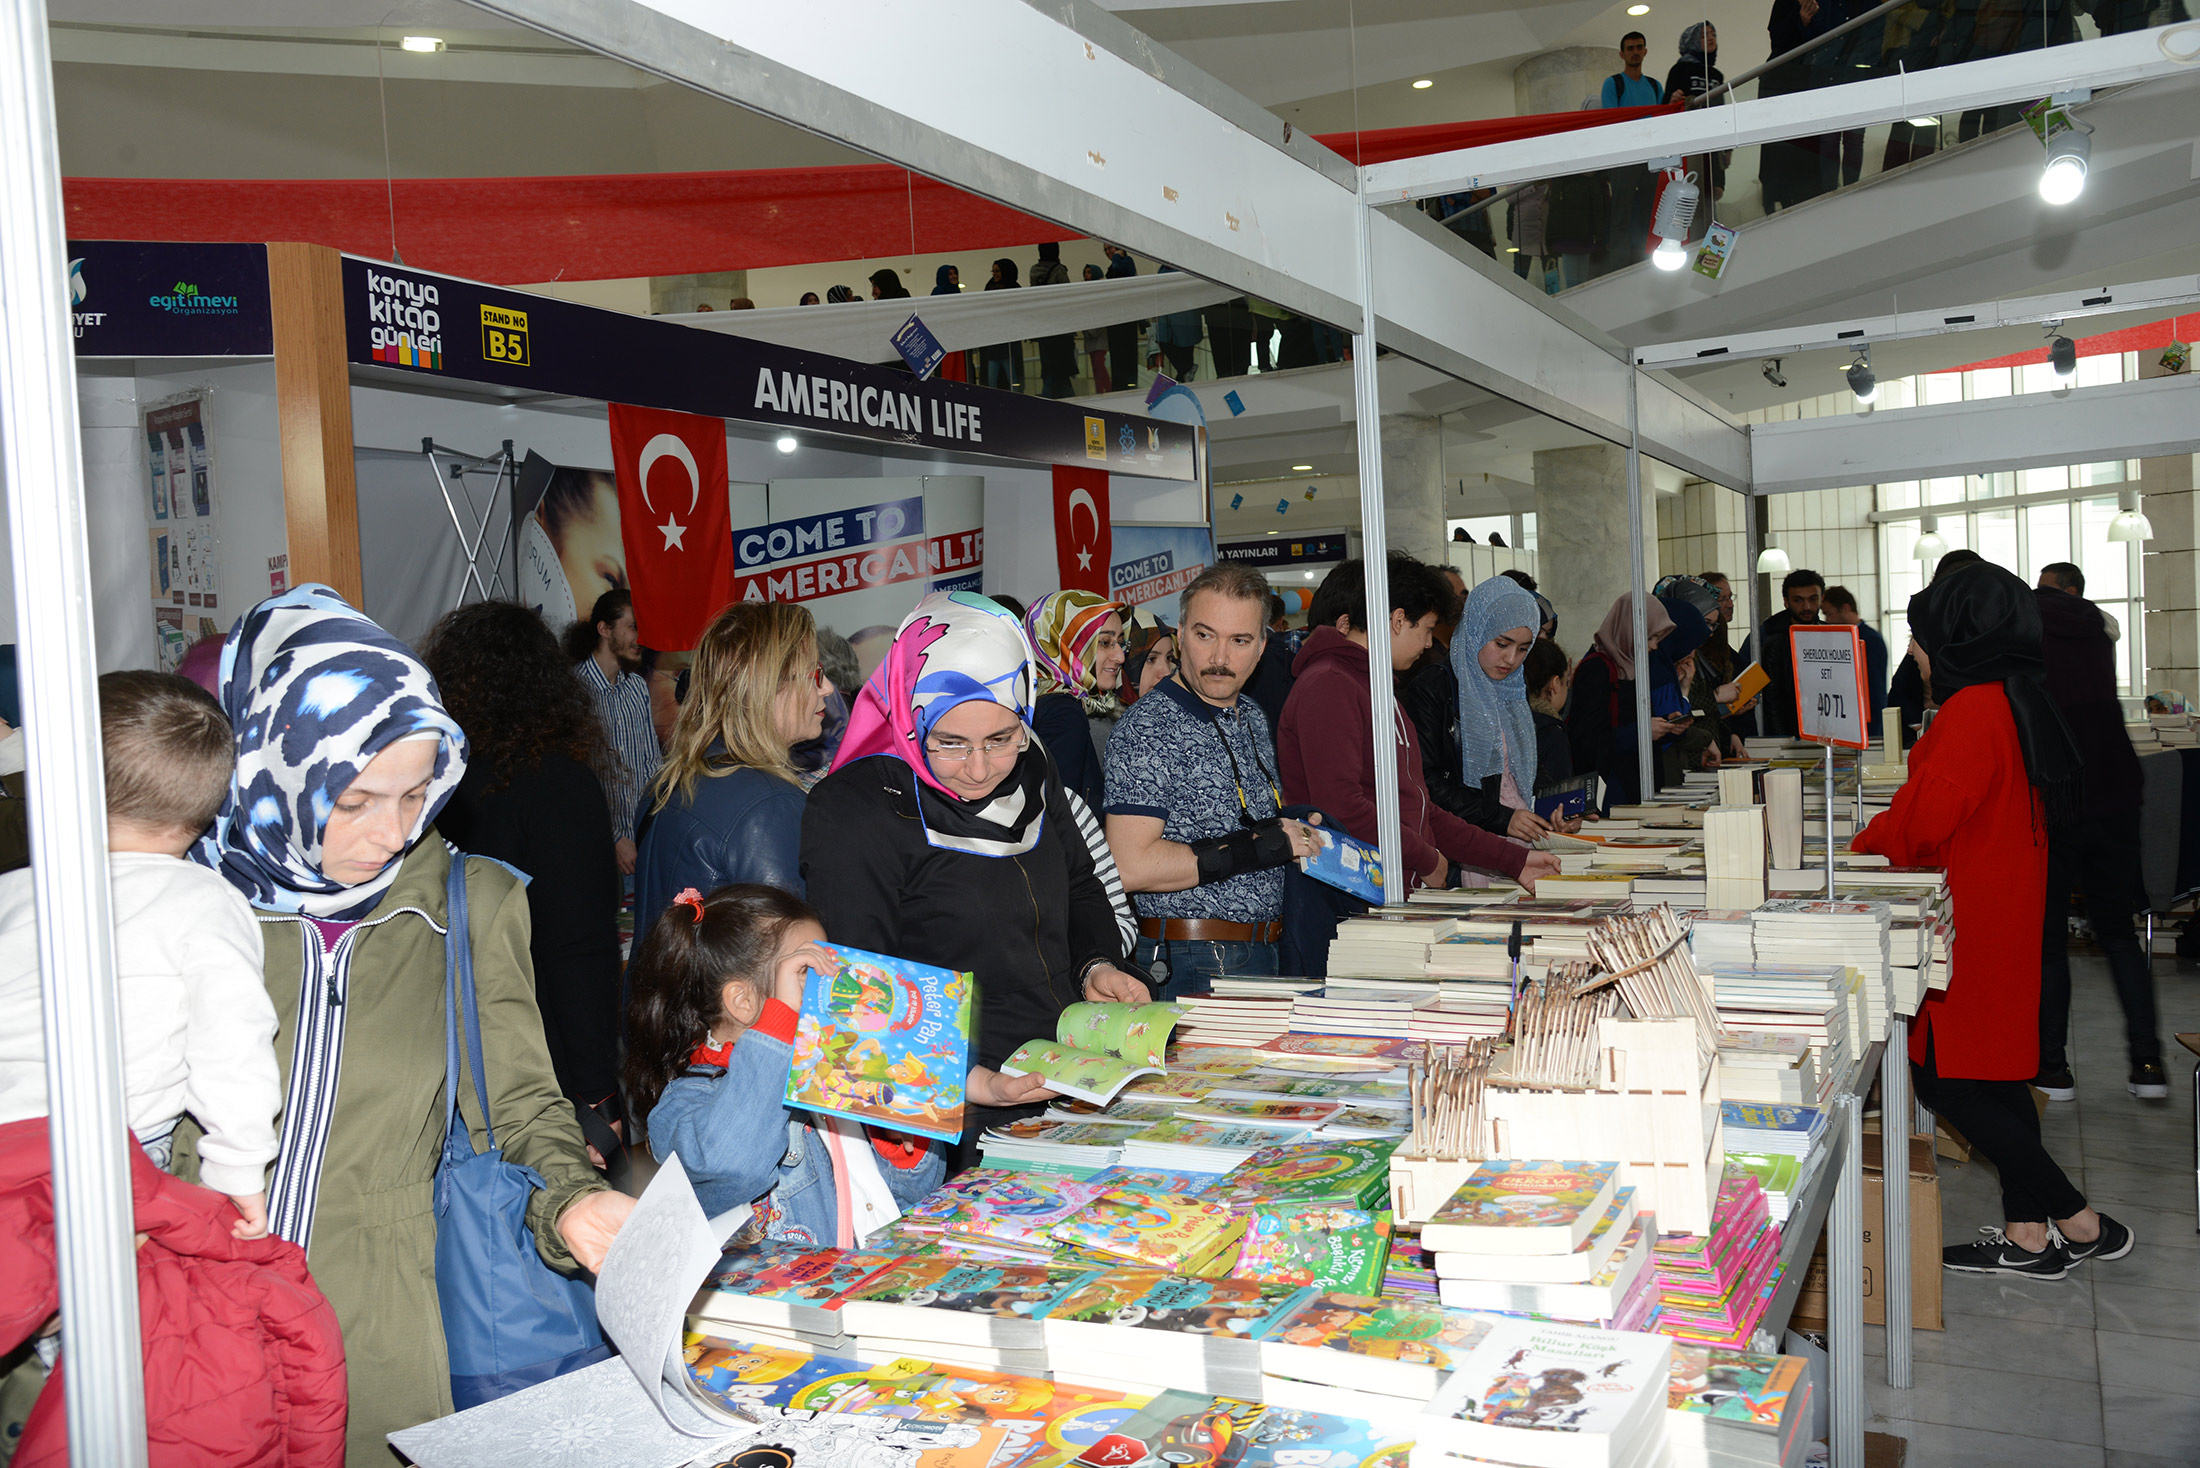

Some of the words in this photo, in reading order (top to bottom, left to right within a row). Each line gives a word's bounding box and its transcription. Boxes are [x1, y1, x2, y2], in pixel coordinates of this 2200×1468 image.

[367, 269, 439, 307] konya
[173, 307, 238, 316] Organizasyon
[369, 293, 440, 335] kitap
[483, 310, 510, 325] STAND
[513, 315, 526, 328] NO
[371, 326, 442, 354] günleri
[489, 330, 523, 362] B5
[754, 367, 922, 433] AMERICAN
[931, 399, 982, 442] LIFE
[739, 516, 846, 565] COME
[855, 507, 906, 541] TO
[268, 554, 288, 571] KAMP
[1226, 547, 1278, 559] YAYINLARI
[1115, 561, 1151, 585] COME
[1152, 554, 1169, 572] TO
[1803, 648, 1828, 660] SHERLOCK
[1829, 649, 1851, 660] HOLMES
[1817, 692, 1831, 717] 40
[1833, 694, 1846, 719] TL
[919, 975, 943, 1018] Peter
[913, 1019, 943, 1045] Pan
[1327, 1235, 1348, 1275] Başlıklı
[1341, 1249, 1366, 1285] Kırmızı
[1530, 1335, 1574, 1348] Billur
